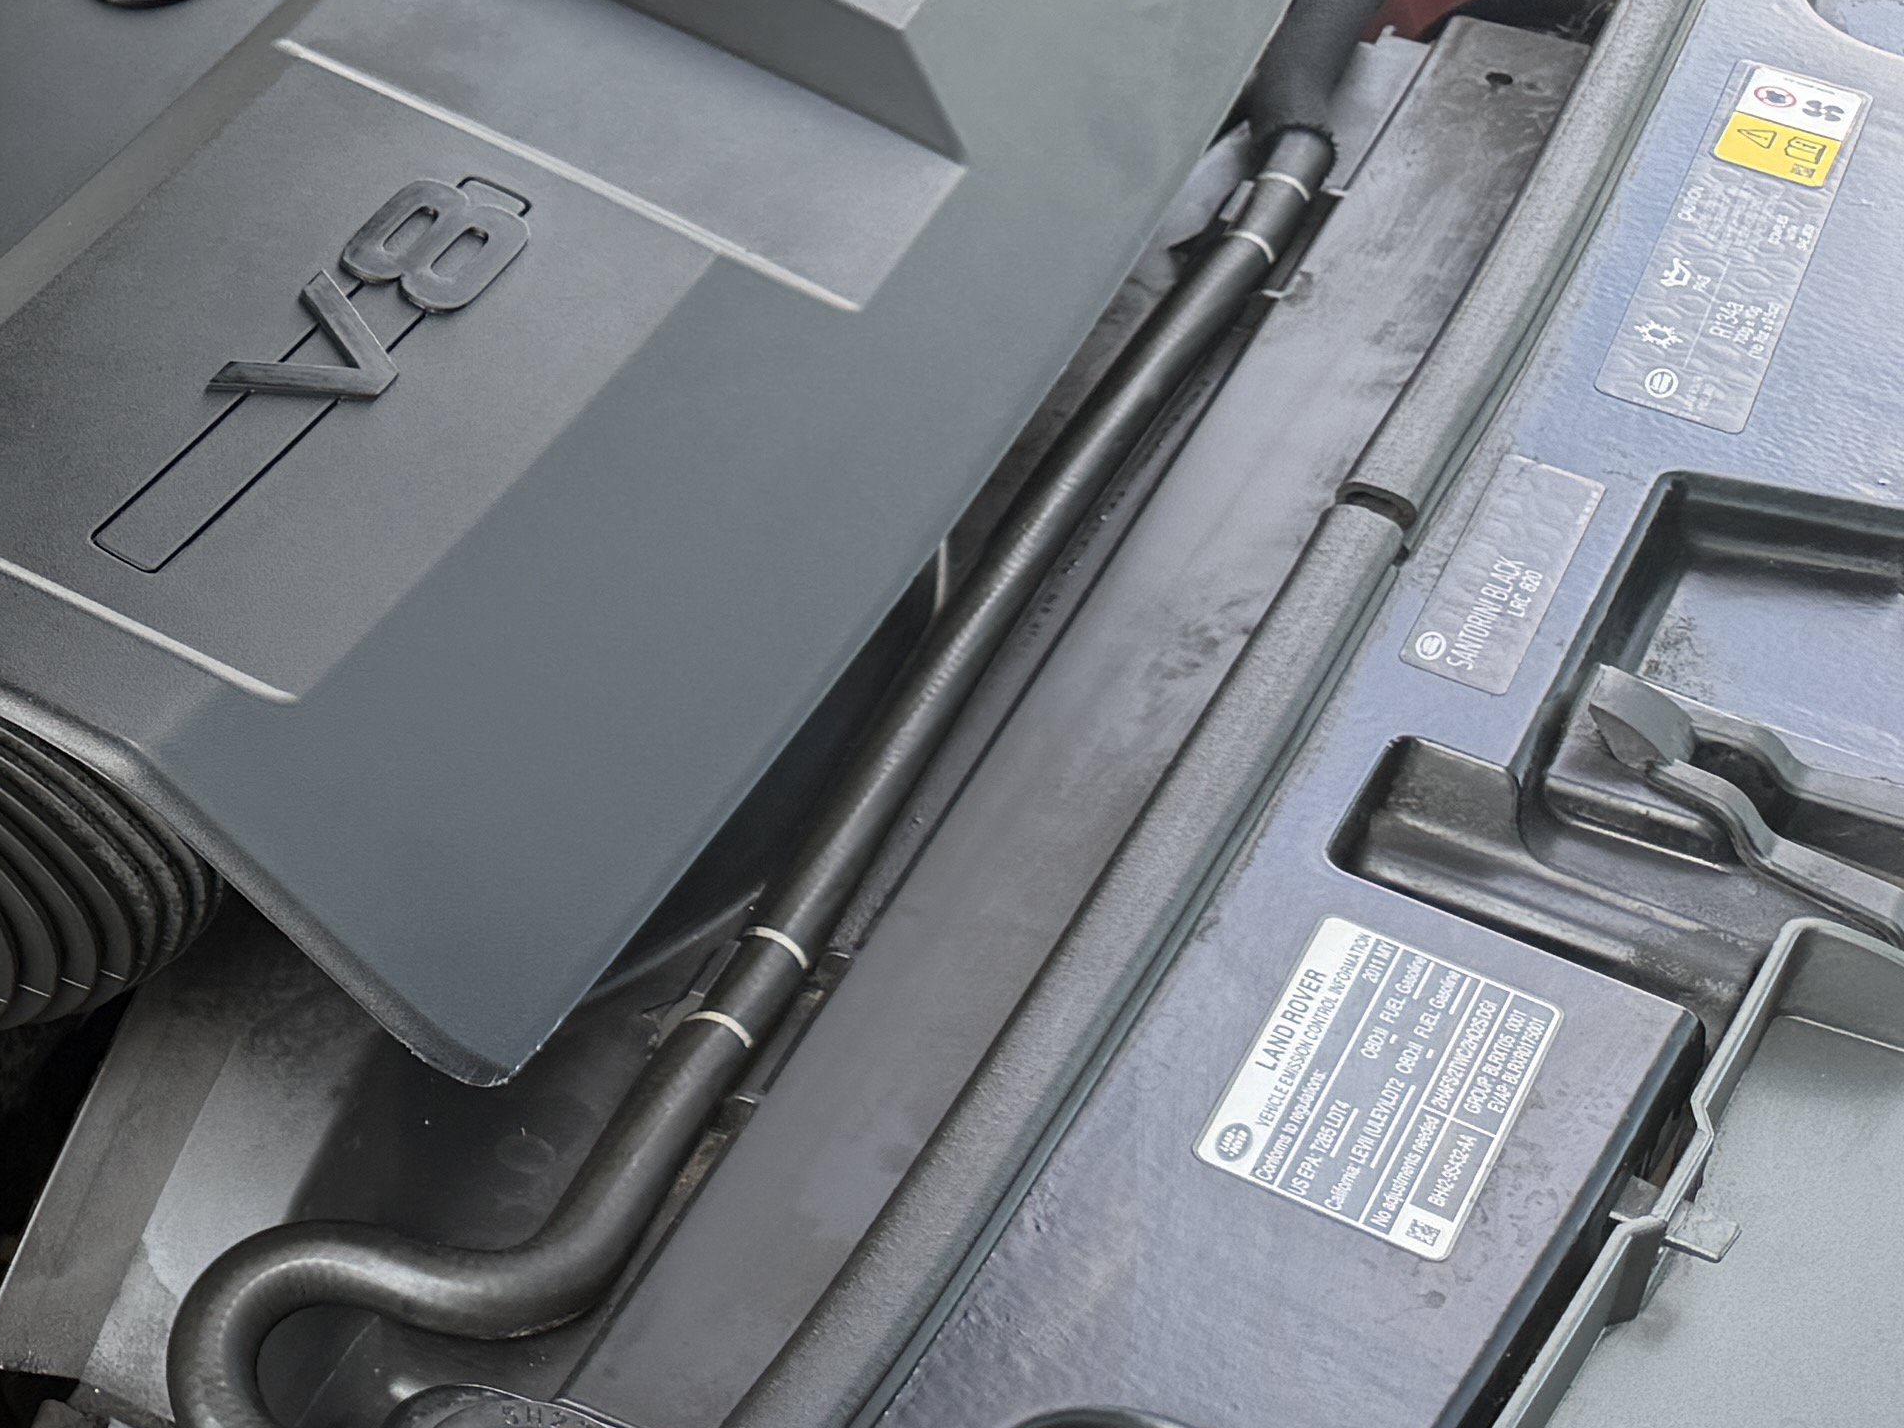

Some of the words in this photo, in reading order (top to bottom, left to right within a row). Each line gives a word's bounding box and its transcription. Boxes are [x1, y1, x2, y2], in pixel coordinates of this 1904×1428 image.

[206, 178, 530, 401] V8
[1708, 298, 1745, 339] R134a
[1518, 568, 1543, 592] 820
[1444, 596, 1503, 671] SANTORINI
[1479, 554, 1524, 601] BLACK
[1505, 592, 1532, 618] LRC
[1360, 956, 1387, 983] 2011
[1372, 940, 1395, 960] MY
[1392, 953, 1428, 995] Gasoline
[1254, 1022, 1297, 1072] LAND
[1280, 967, 1327, 1024] ROVER
[1377, 990, 1408, 1024] FUEL:
[1412, 1006, 1442, 1039] FUEL:
[1427, 967, 1462, 1010] Gasoline
[1254, 1084, 1290, 1129] VEHICLE
[1277, 1037, 1315, 1087] EMISSION
[1302, 992, 1339, 1041] CONTROL
[1326, 930, 1373, 995] INFORMATION
[1284, 1066, 1331, 1125] regulations:
[1322, 1098, 1351, 1129] LDT4
[1462, 1072, 1496, 1115] GROUP:
[1486, 1080, 1516, 1114] EVAP:
[1279, 1119, 1300, 1135] to
[1407, 1113, 1440, 1154] needed
[1254, 1131, 1294, 1182] Conforms
[1296, 1151, 1324, 1181] EPA:
[1287, 1175, 1311, 1197] US
[1323, 1160, 1363, 1212] California:
[1378, 1150, 1425, 1213] adjustments
[1369, 1207, 1392, 1228] No
